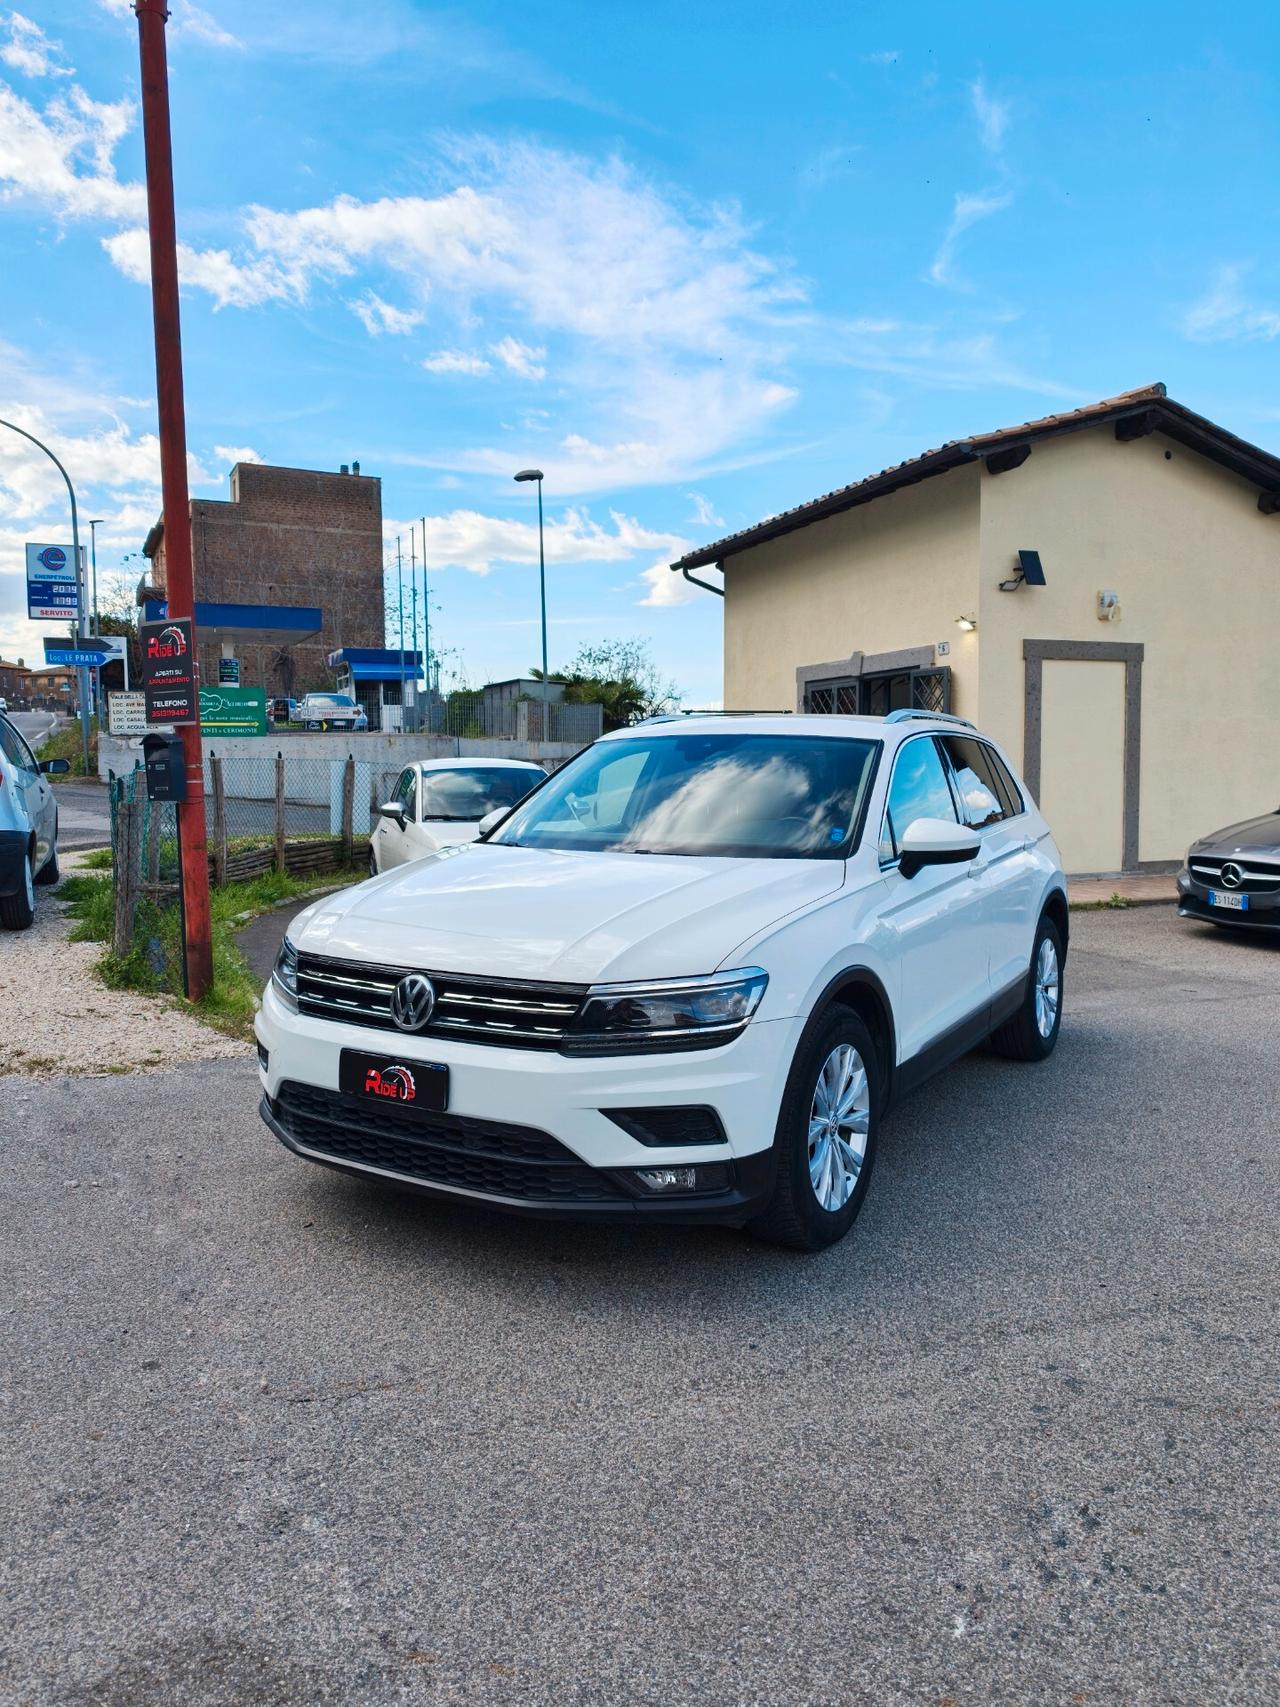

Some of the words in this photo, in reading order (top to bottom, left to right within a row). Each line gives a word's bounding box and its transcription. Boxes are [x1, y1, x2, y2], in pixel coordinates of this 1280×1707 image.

[148, 637, 172, 658] RIDE
[75, 654, 98, 663] PRATA
[152, 699, 188, 708] TELEFONO
[365, 1069, 398, 1098] RIDE
[399, 1085, 417, 1101] UP
